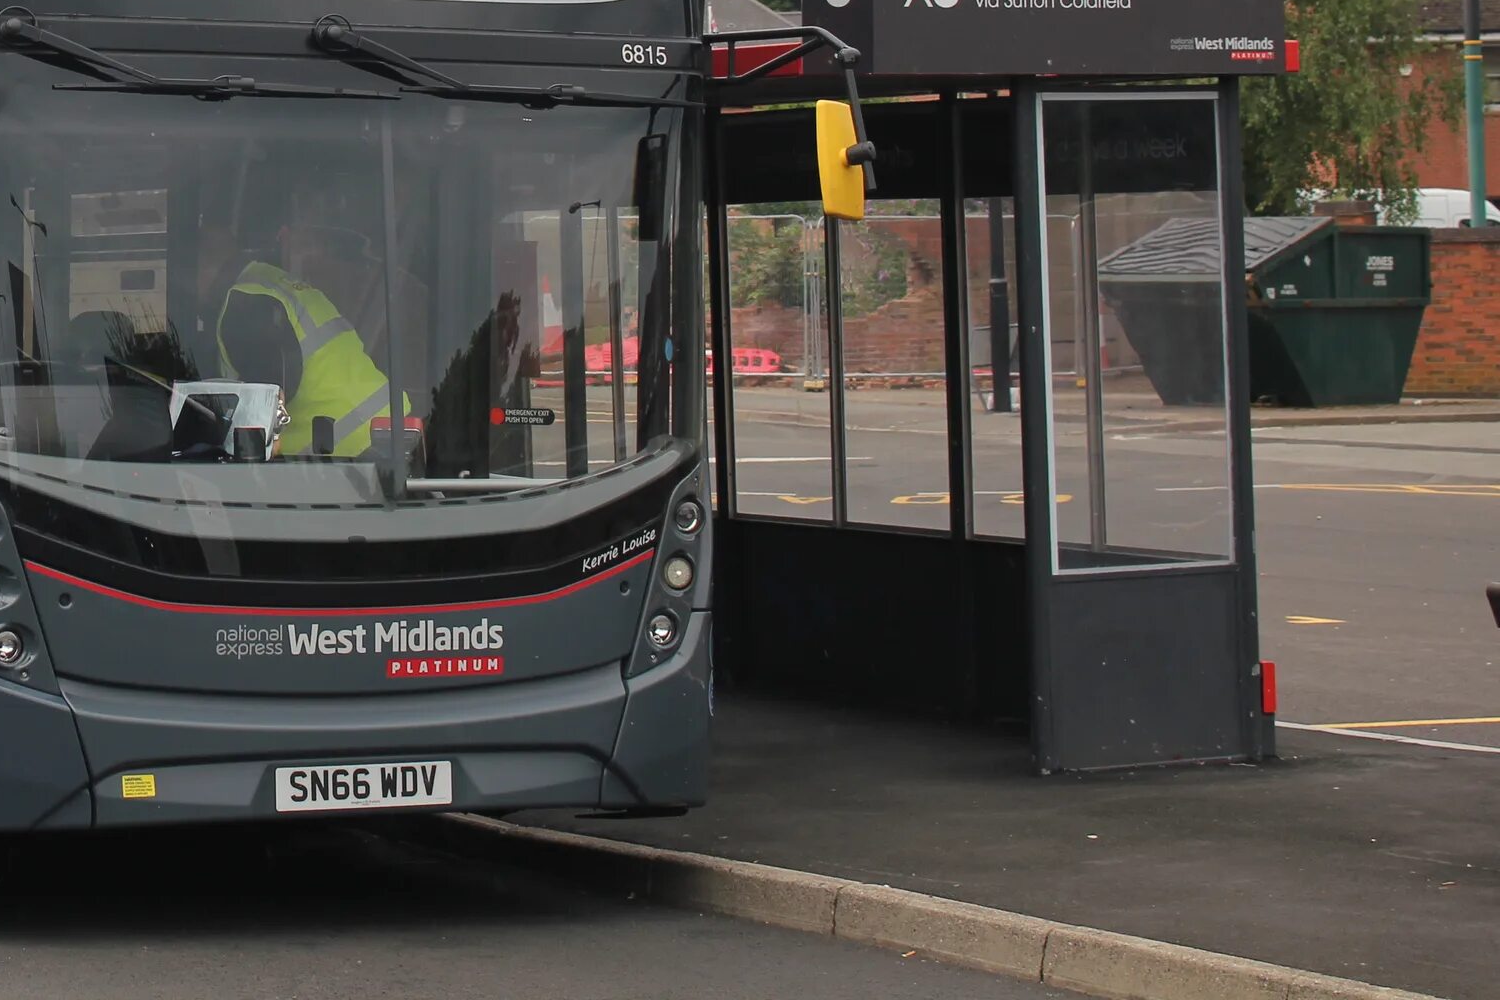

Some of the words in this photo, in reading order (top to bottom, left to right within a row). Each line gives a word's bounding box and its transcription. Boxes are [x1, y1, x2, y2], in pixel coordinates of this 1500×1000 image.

[1194, 37, 1223, 50] West
[1225, 36, 1274, 50] Midlands
[621, 44, 668, 65] 6815
[1366, 256, 1393, 266] JONES
[582, 545, 618, 572] Kerrie
[622, 529, 656, 554] Louise
[216, 624, 283, 641] national
[288, 623, 366, 655] West
[374, 618, 503, 653] Midlands
[216, 641, 283, 659] express
[391, 658, 499, 674] PLATINUM
[290, 768, 371, 802] SN66
[380, 765, 437, 799] WDV
